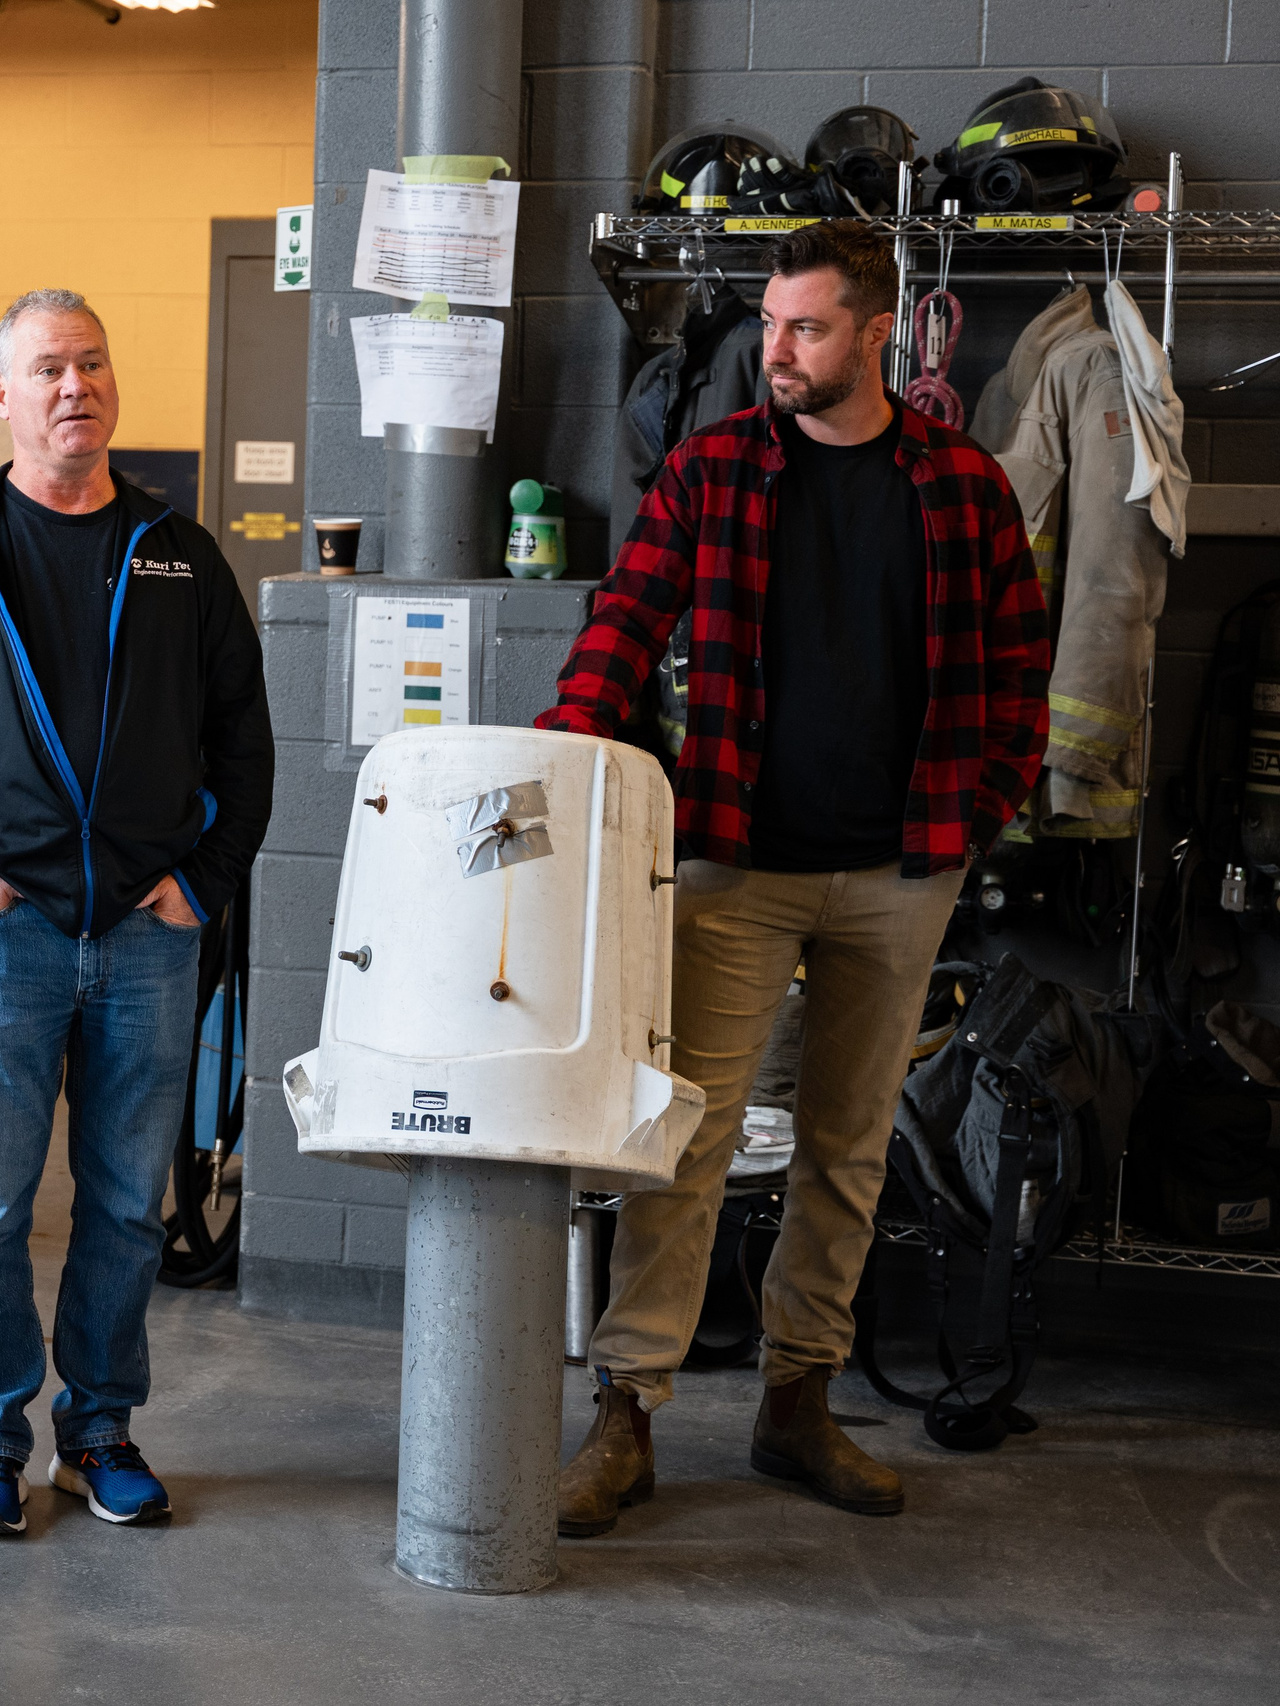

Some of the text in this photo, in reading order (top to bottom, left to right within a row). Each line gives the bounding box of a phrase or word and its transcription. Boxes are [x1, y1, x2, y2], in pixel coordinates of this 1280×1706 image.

[1014, 129, 1066, 142] MICHAEL
[740, 220, 751, 230] A.
[993, 218, 1052, 228] M. MATAS
[280, 256, 309, 269] EYE WASH
[930, 337, 942, 355] 12
[145, 560, 169, 570] Kuri
[1250, 752, 1280, 771] SA
[391, 1112, 472, 1135] BRUTE
